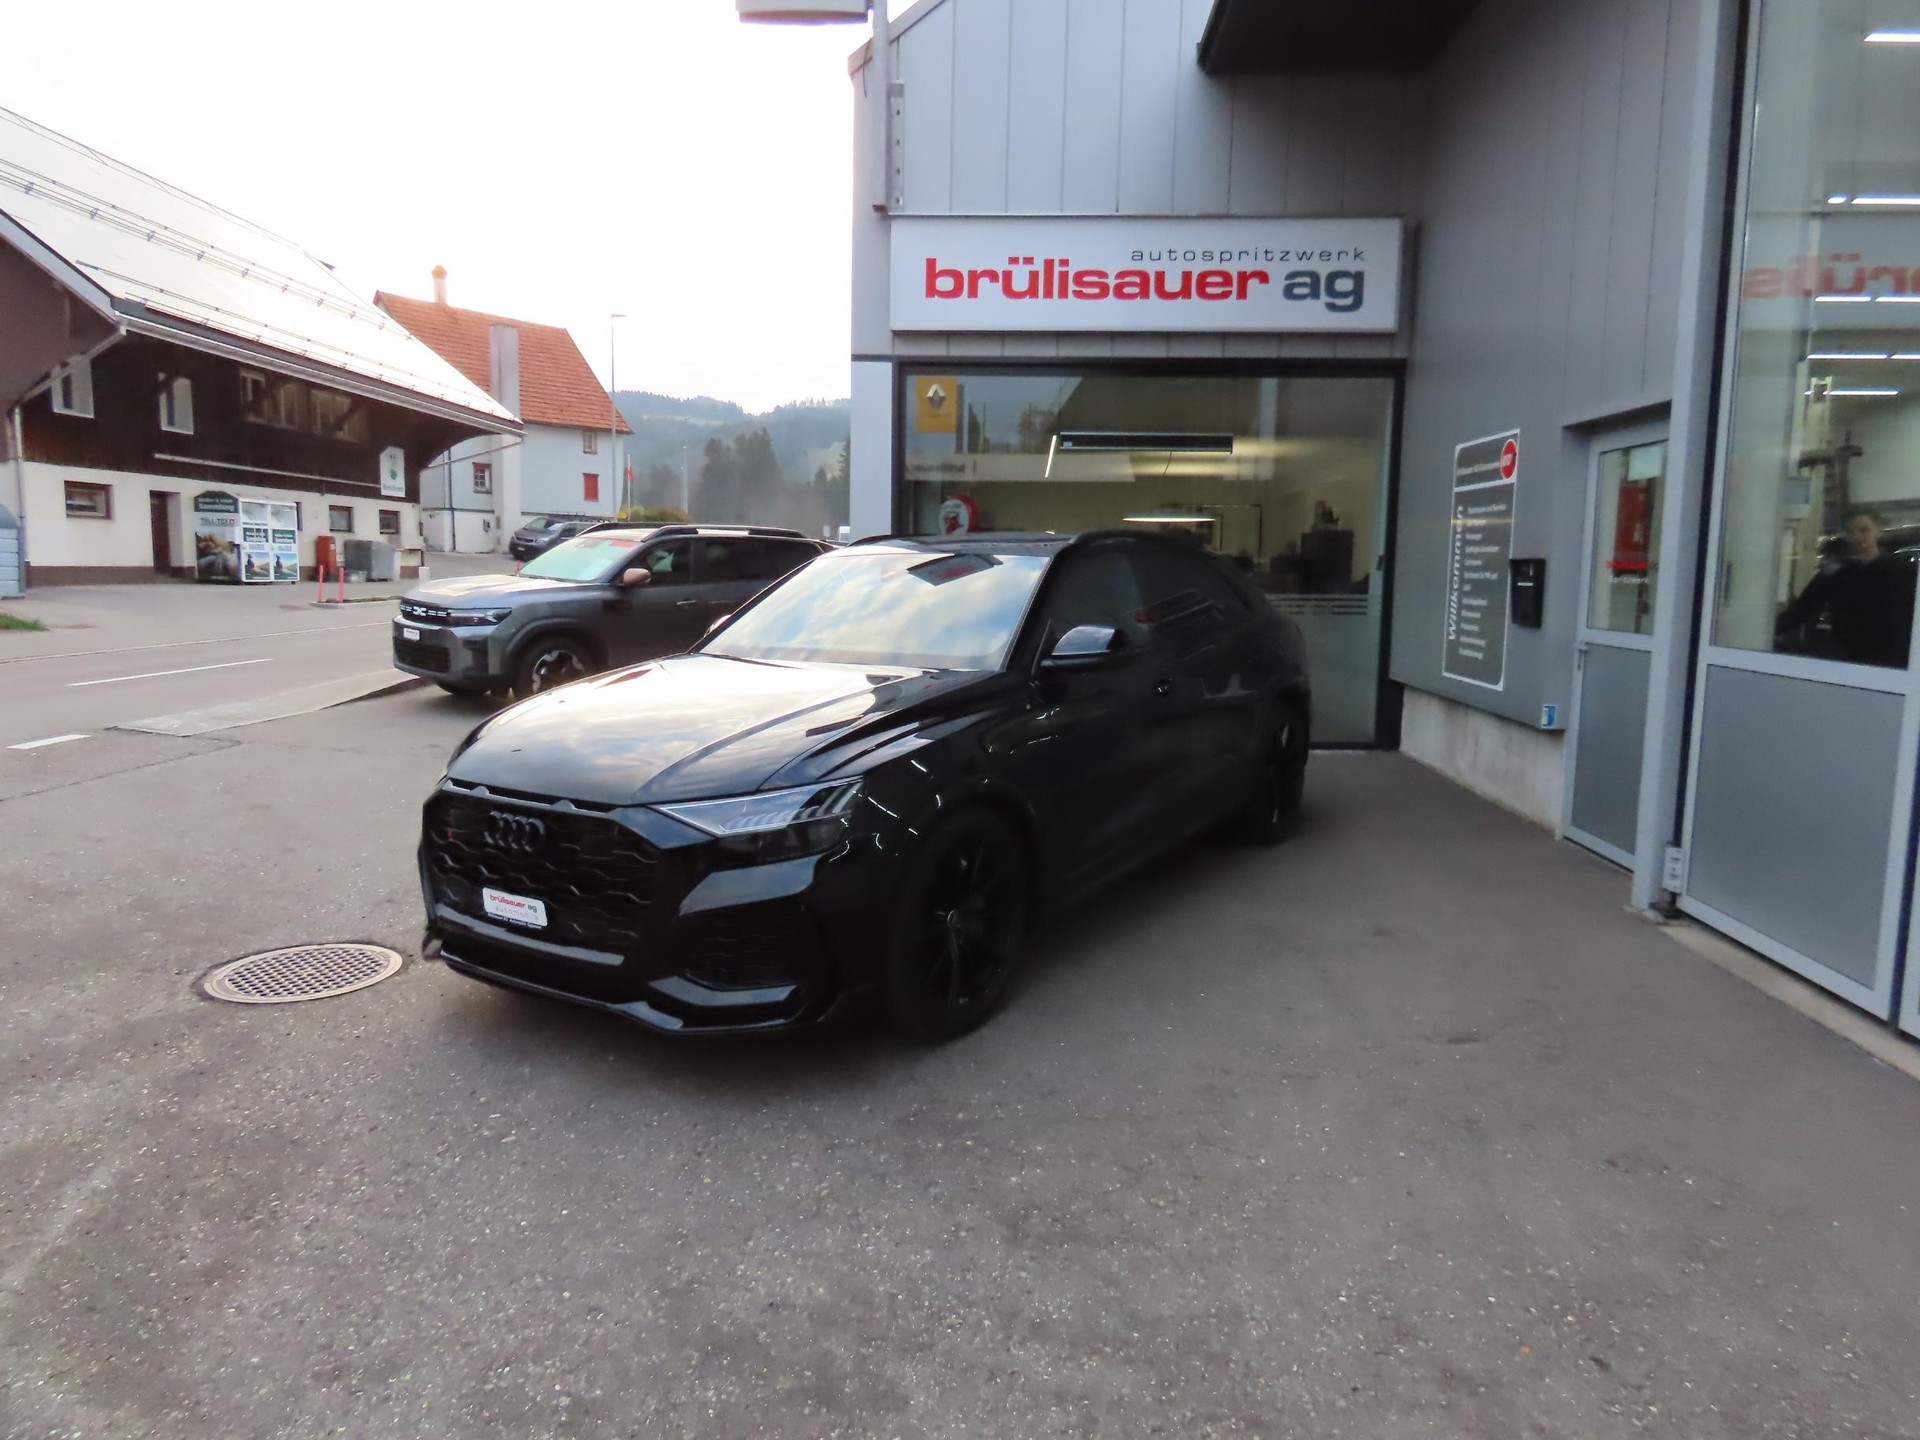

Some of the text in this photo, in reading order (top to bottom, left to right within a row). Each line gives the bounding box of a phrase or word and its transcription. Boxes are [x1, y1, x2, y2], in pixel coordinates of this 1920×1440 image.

[924, 255, 1366, 314] brülisauer ag
[1130, 246, 1367, 265] autospritzwerk
[1447, 505, 1464, 640] Willkommen
